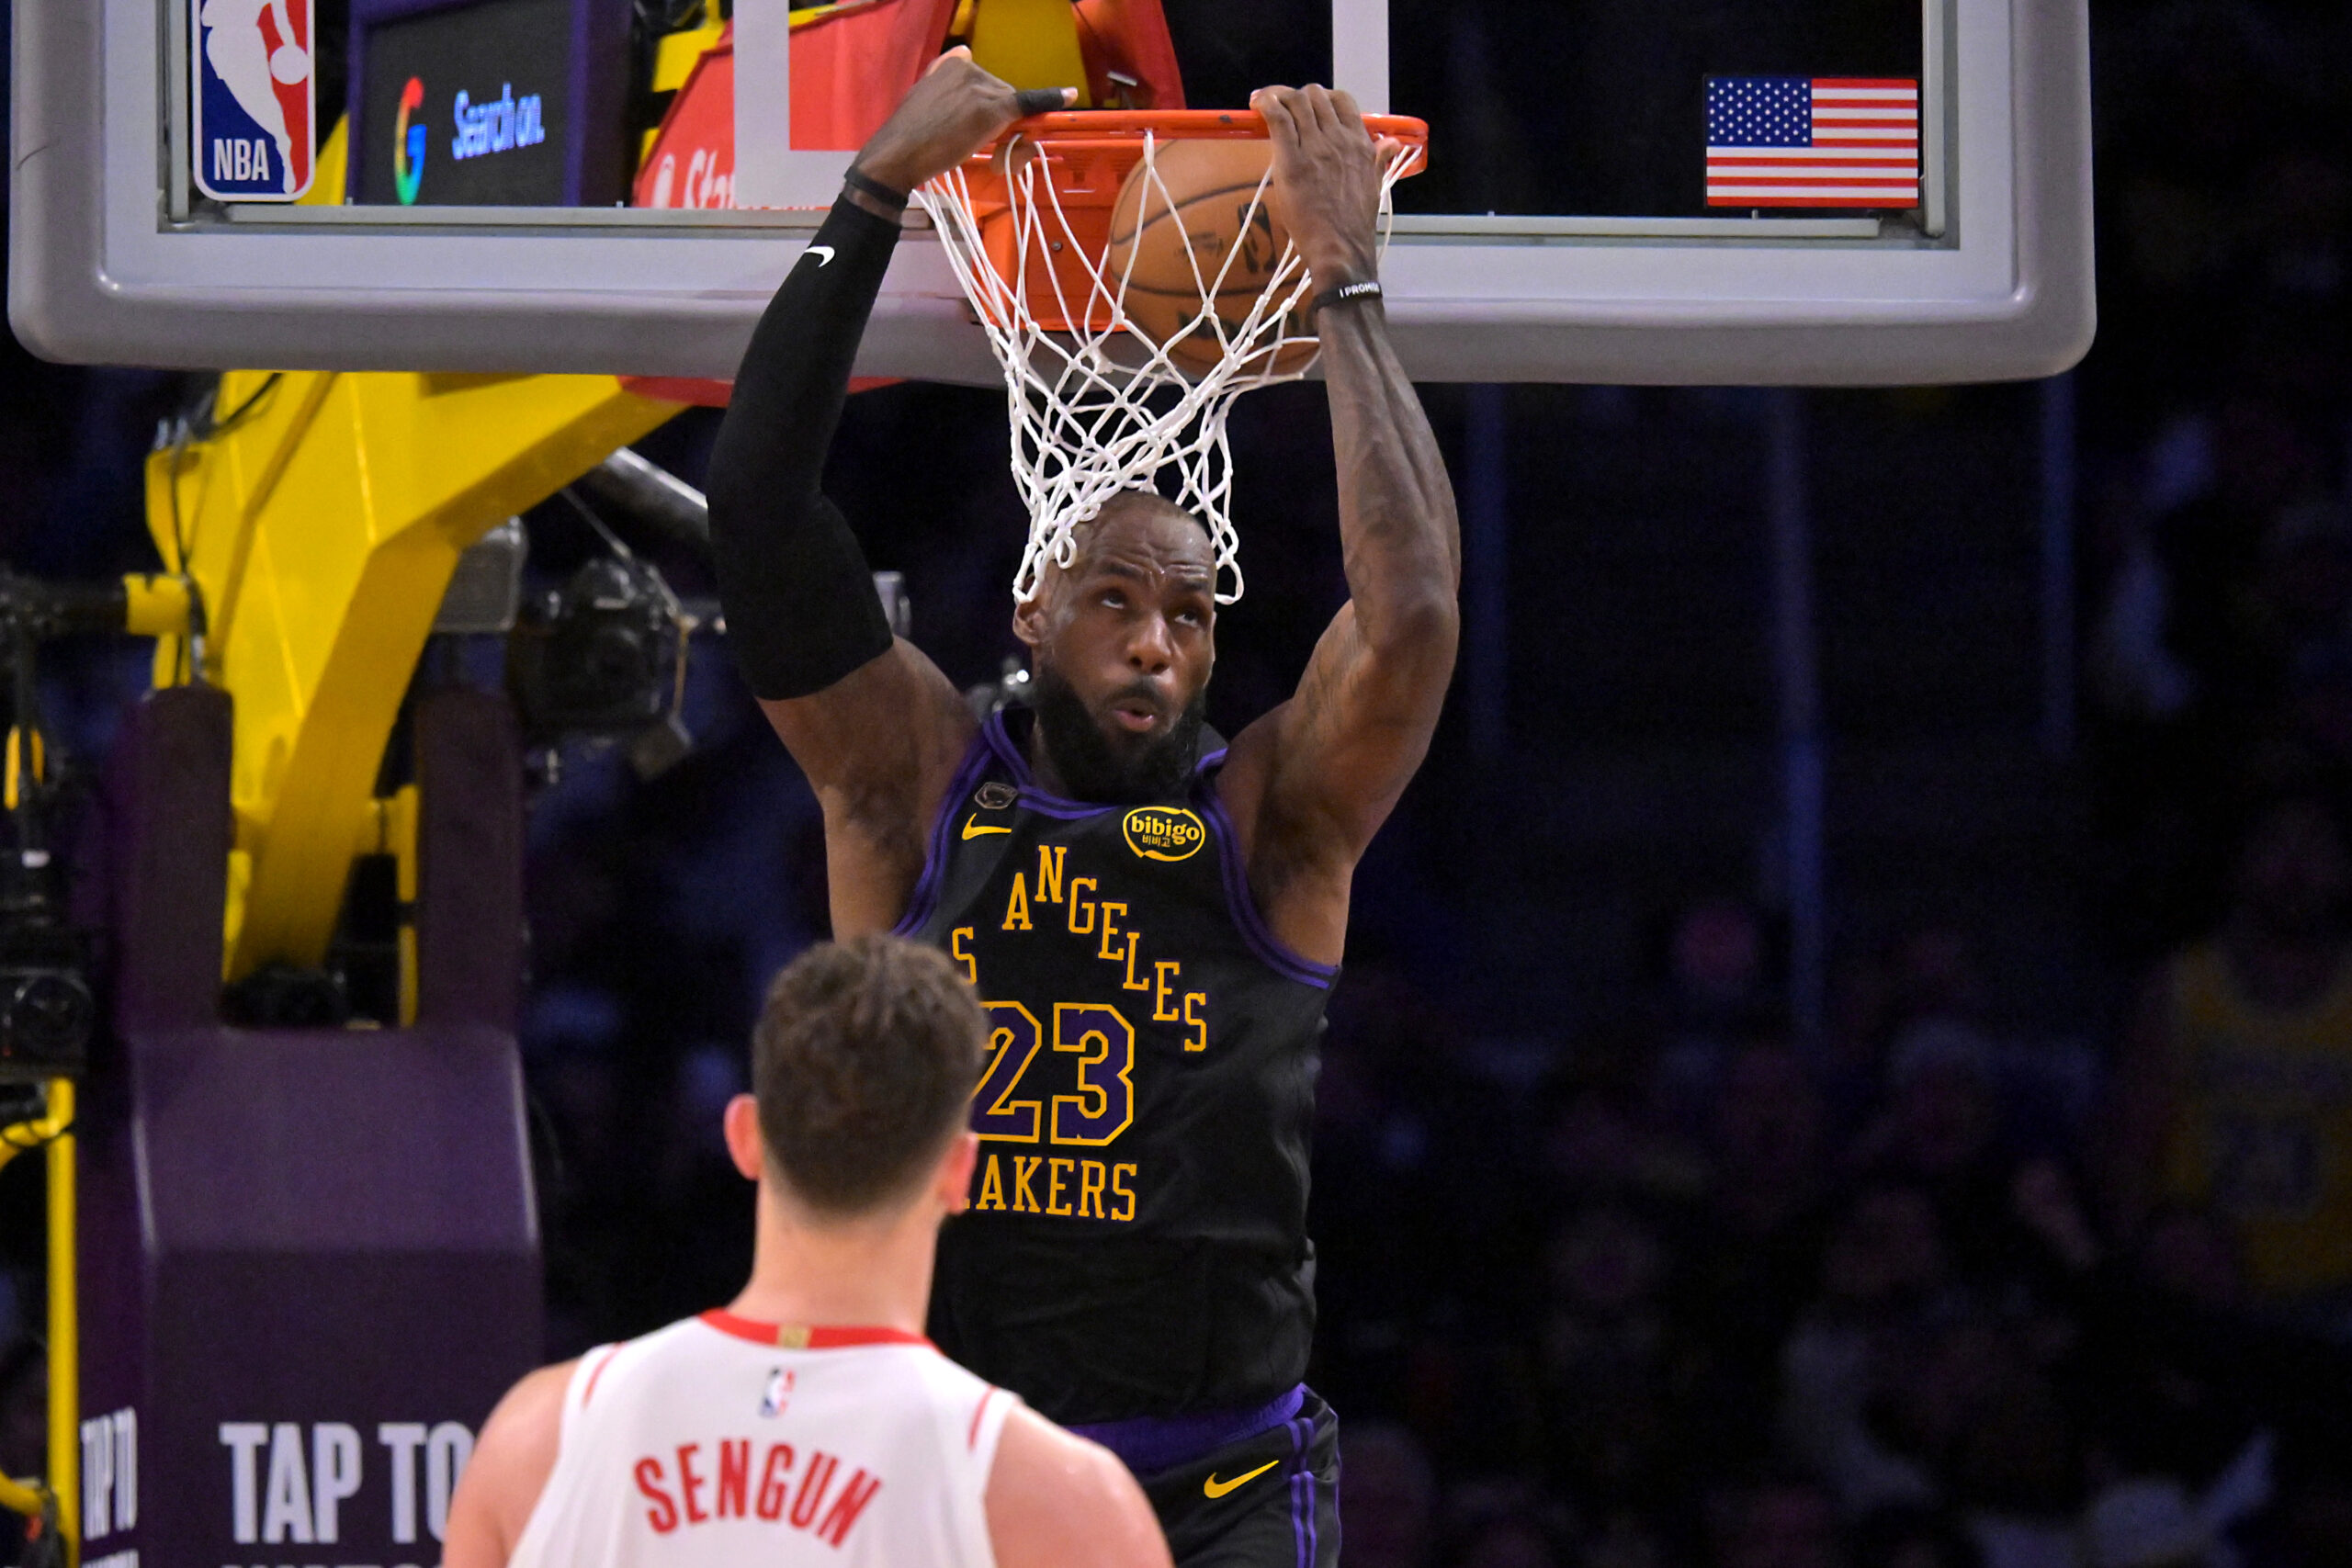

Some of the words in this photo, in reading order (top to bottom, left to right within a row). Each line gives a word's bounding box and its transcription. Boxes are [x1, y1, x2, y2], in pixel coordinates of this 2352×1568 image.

[213, 138, 270, 181] NBA
[452, 81, 514, 160] Search
[1131, 815, 1201, 845] bibigo
[1142, 834, 1171, 848] 비비고
[1001, 844, 1207, 1053] ANGELES
[971, 1000, 1136, 1146] 23
[965, 1154, 1138, 1223] AKERS
[219, 1422, 363, 1544] TAP
[378, 1421, 476, 1544] TO
[633, 1438, 882, 1548] SENGUN
